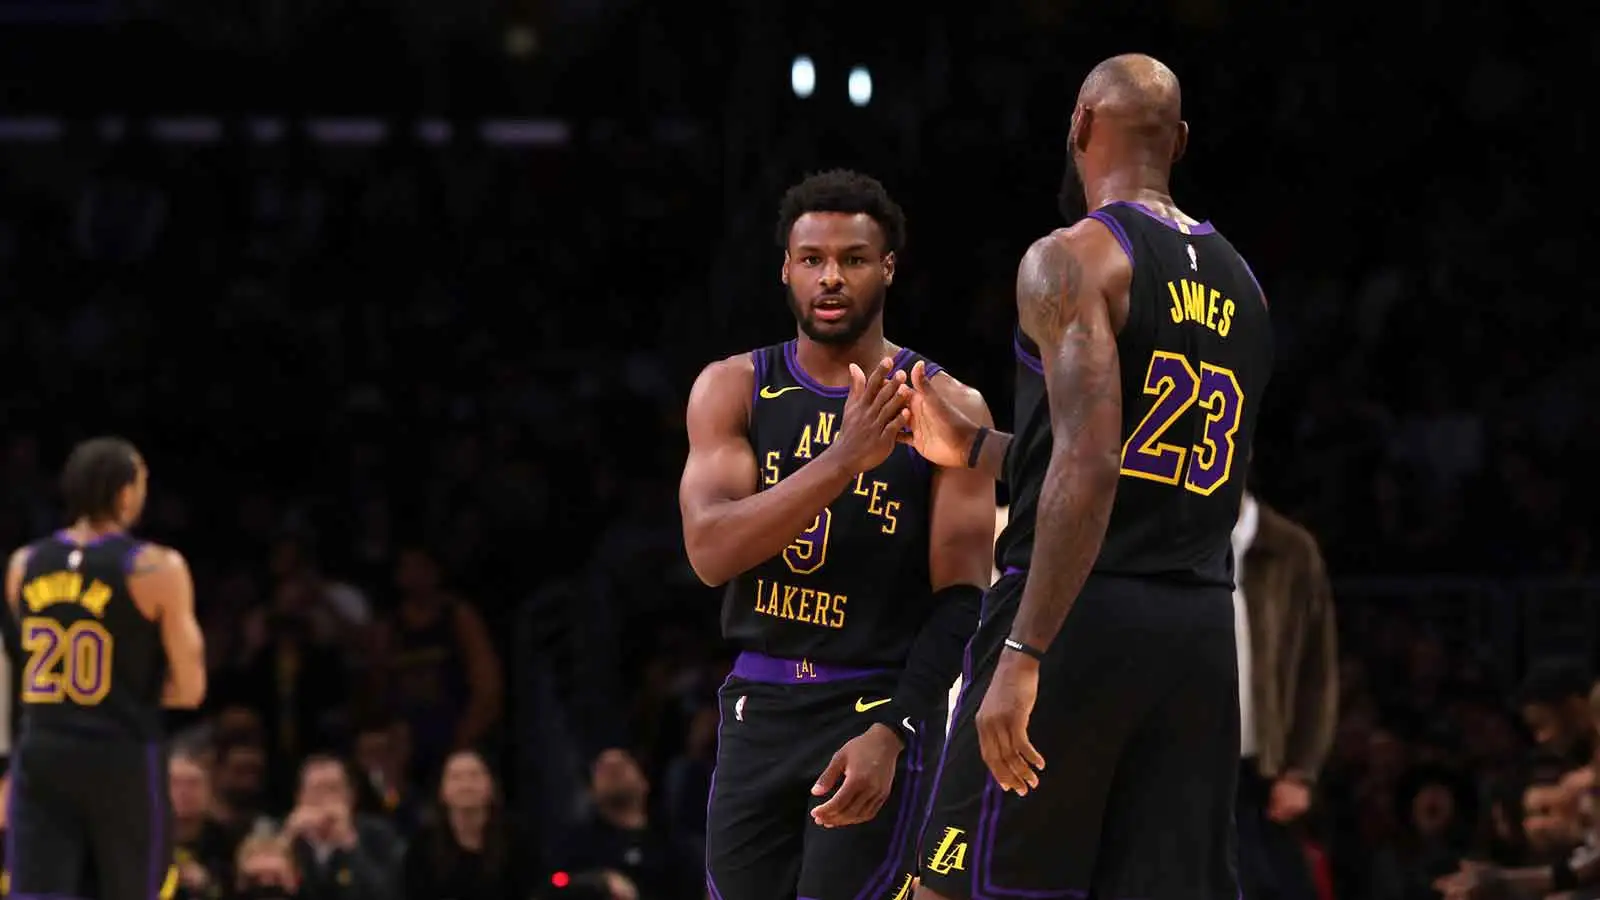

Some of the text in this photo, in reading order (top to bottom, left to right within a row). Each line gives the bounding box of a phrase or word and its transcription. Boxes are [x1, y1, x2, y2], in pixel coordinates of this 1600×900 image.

[1167, 278, 1236, 338] JAMES
[1119, 350, 1245, 497] 23
[794, 411, 901, 535] ANLES
[754, 579, 848, 629] LAKERS
[21, 616, 115, 706] 20
[796, 656, 817, 679] LAL
[926, 825, 969, 876] LA
